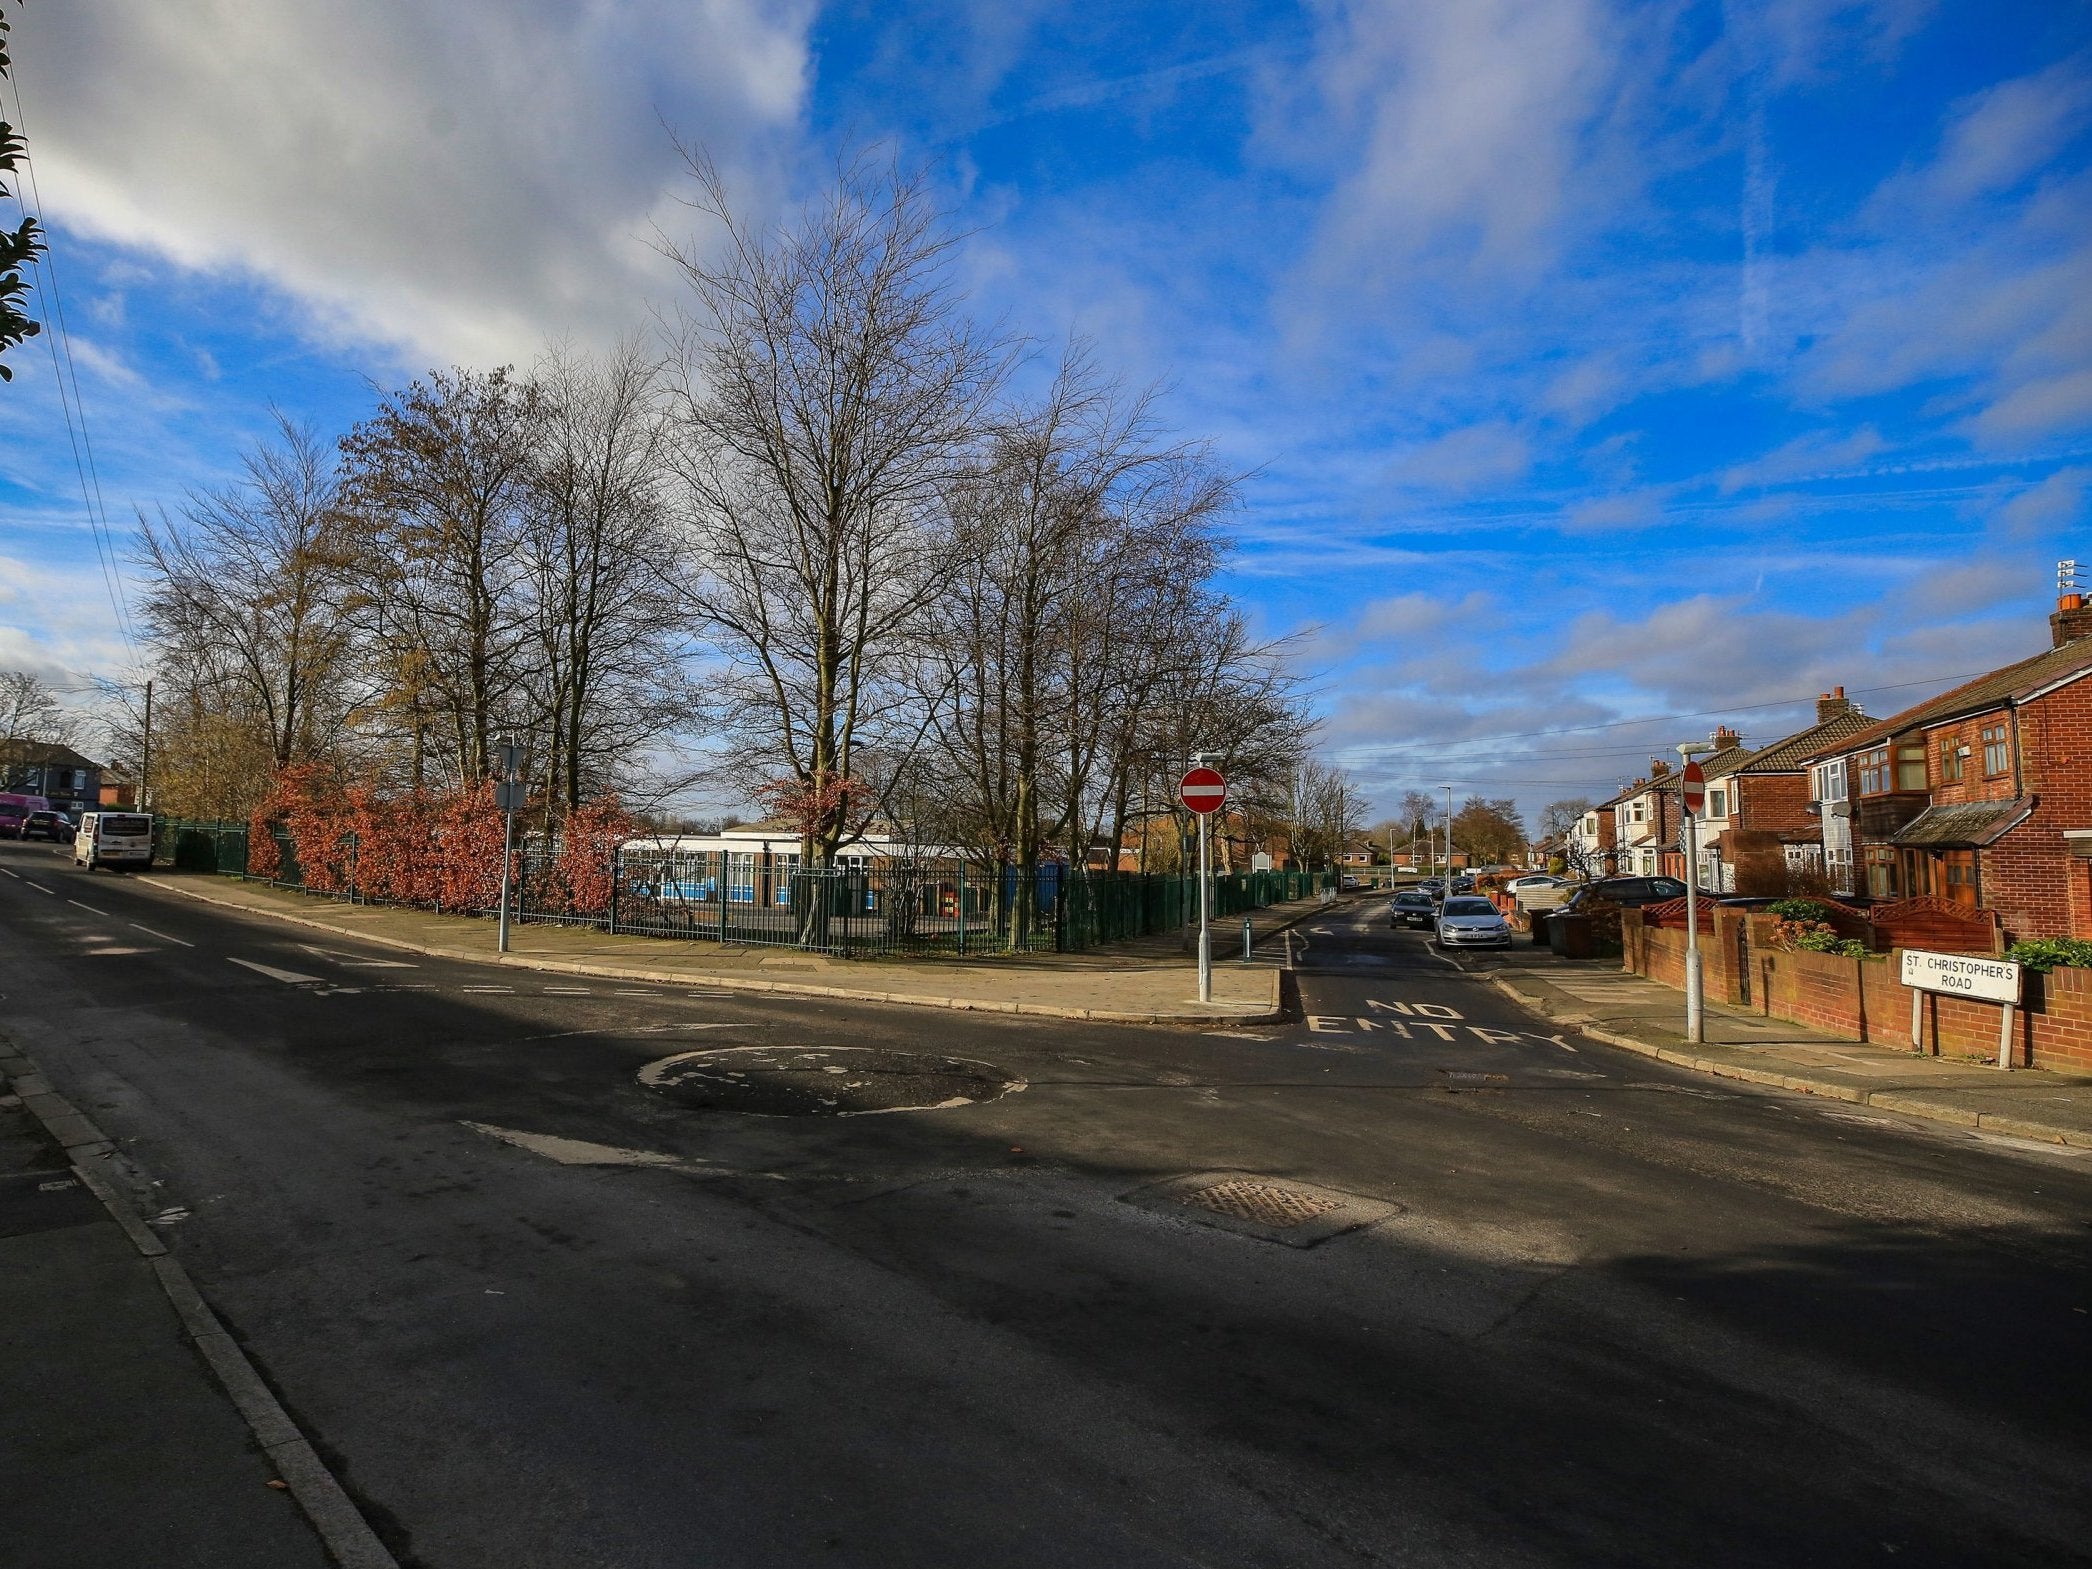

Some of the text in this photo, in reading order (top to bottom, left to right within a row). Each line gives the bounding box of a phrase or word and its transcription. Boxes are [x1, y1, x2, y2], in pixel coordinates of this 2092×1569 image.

[1906, 955, 2013, 980] ST. CHRISTOPHER'S
[1941, 975, 1972, 990] ROAD
[1366, 999, 1465, 1020] NO
[1306, 1015, 1579, 1053] ENTRY
